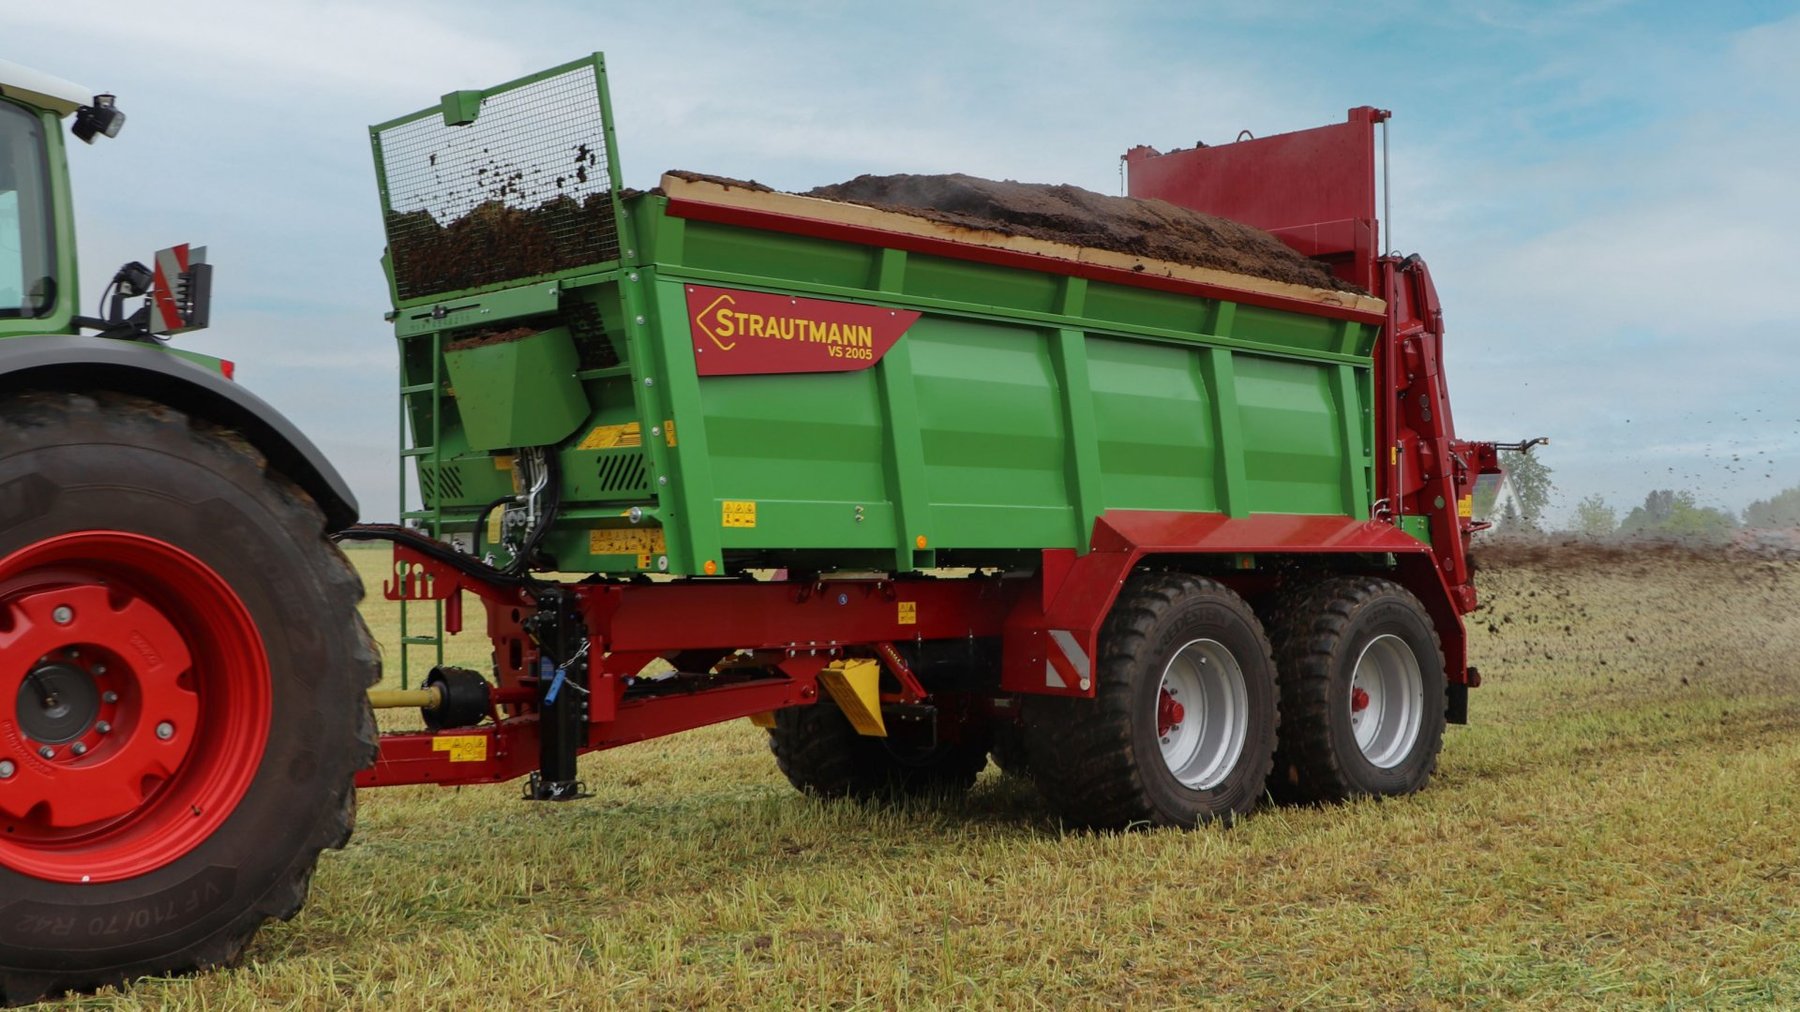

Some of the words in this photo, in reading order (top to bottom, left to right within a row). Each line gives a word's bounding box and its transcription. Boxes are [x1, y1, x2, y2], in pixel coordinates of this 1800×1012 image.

[715, 308, 872, 347] STRAUTMANN
[828, 345, 843, 357] VS
[846, 347, 873, 360] 2005
[88, 902, 178, 935] 710/70
